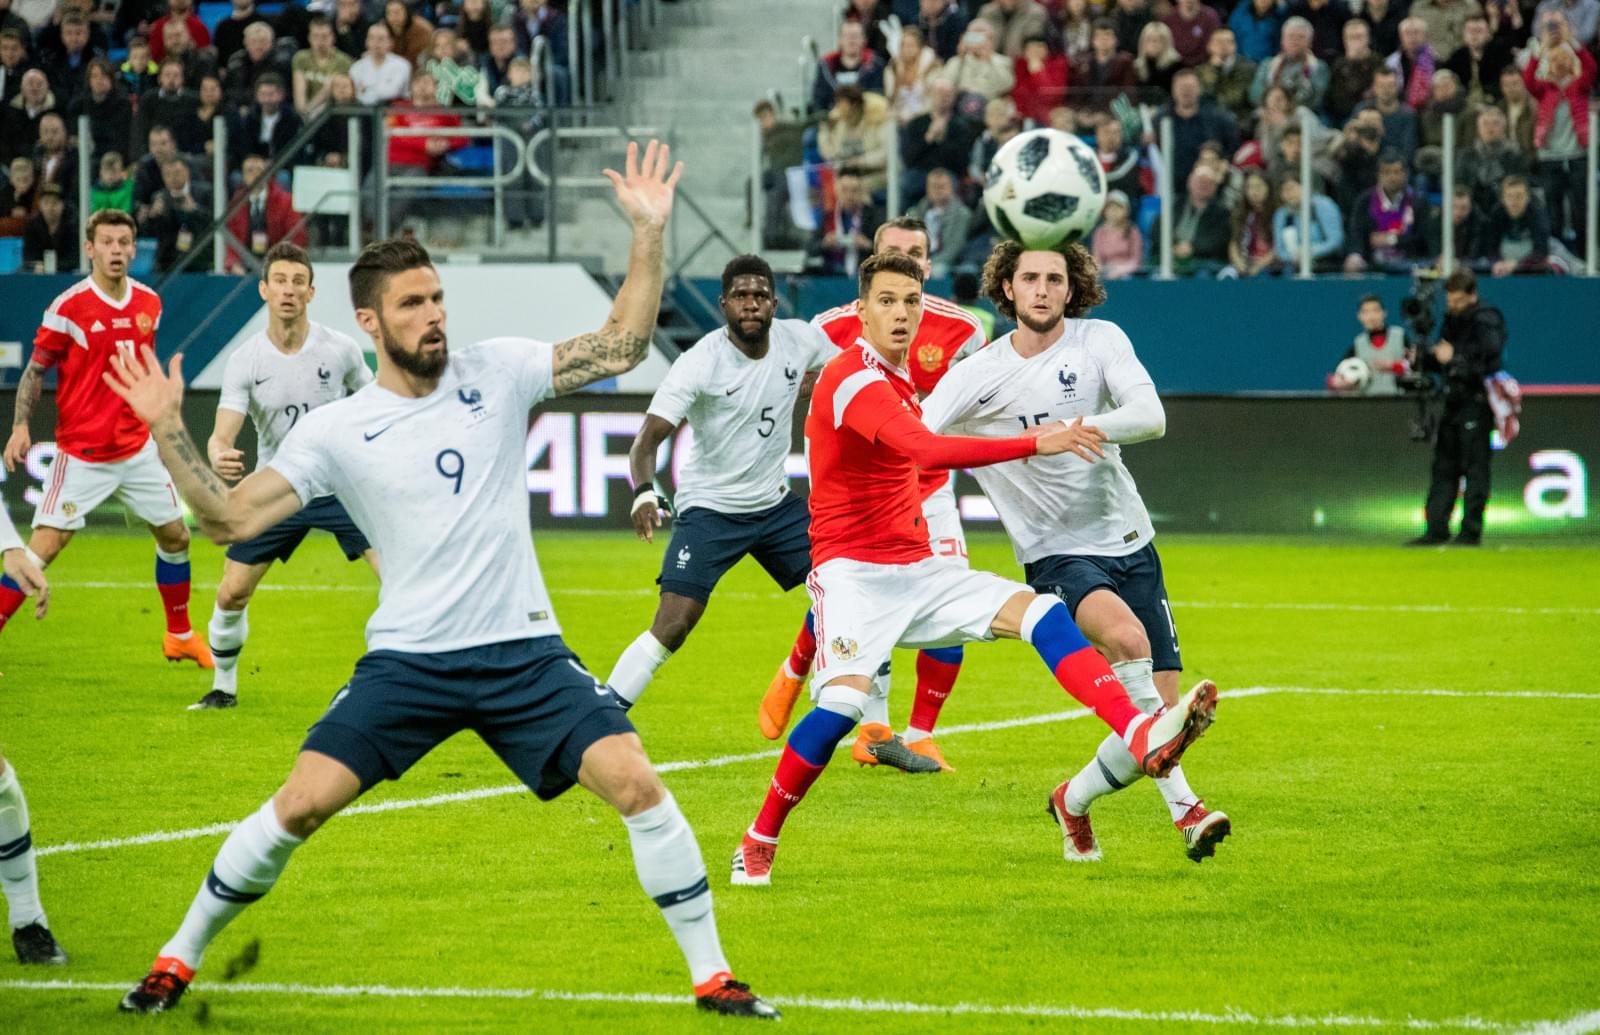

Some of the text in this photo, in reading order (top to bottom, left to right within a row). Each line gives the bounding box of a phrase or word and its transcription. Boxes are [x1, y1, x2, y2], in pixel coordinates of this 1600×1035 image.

[285, 403, 309, 431] 2
[757, 406, 776, 438] 5
[435, 448, 465, 495] 9
